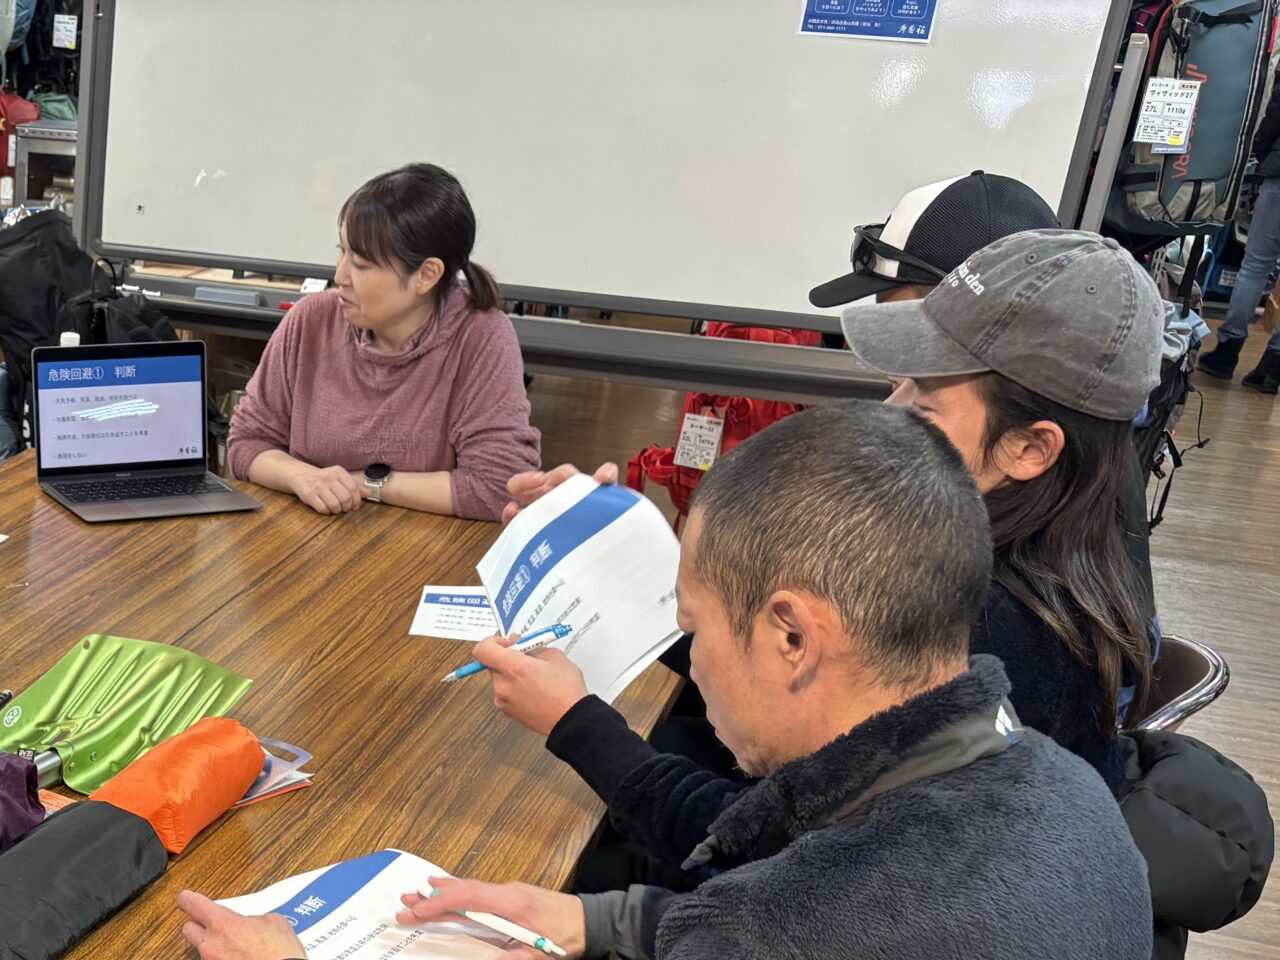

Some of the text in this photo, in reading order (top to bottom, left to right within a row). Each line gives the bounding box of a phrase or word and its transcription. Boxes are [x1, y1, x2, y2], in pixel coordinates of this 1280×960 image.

[1144, 105, 1157, 114] 27L
[1167, 106, 1186, 115] 1110g
[48, 364, 137, 382] 危険回避① 判断
[292, 894, 328, 917] 判断
